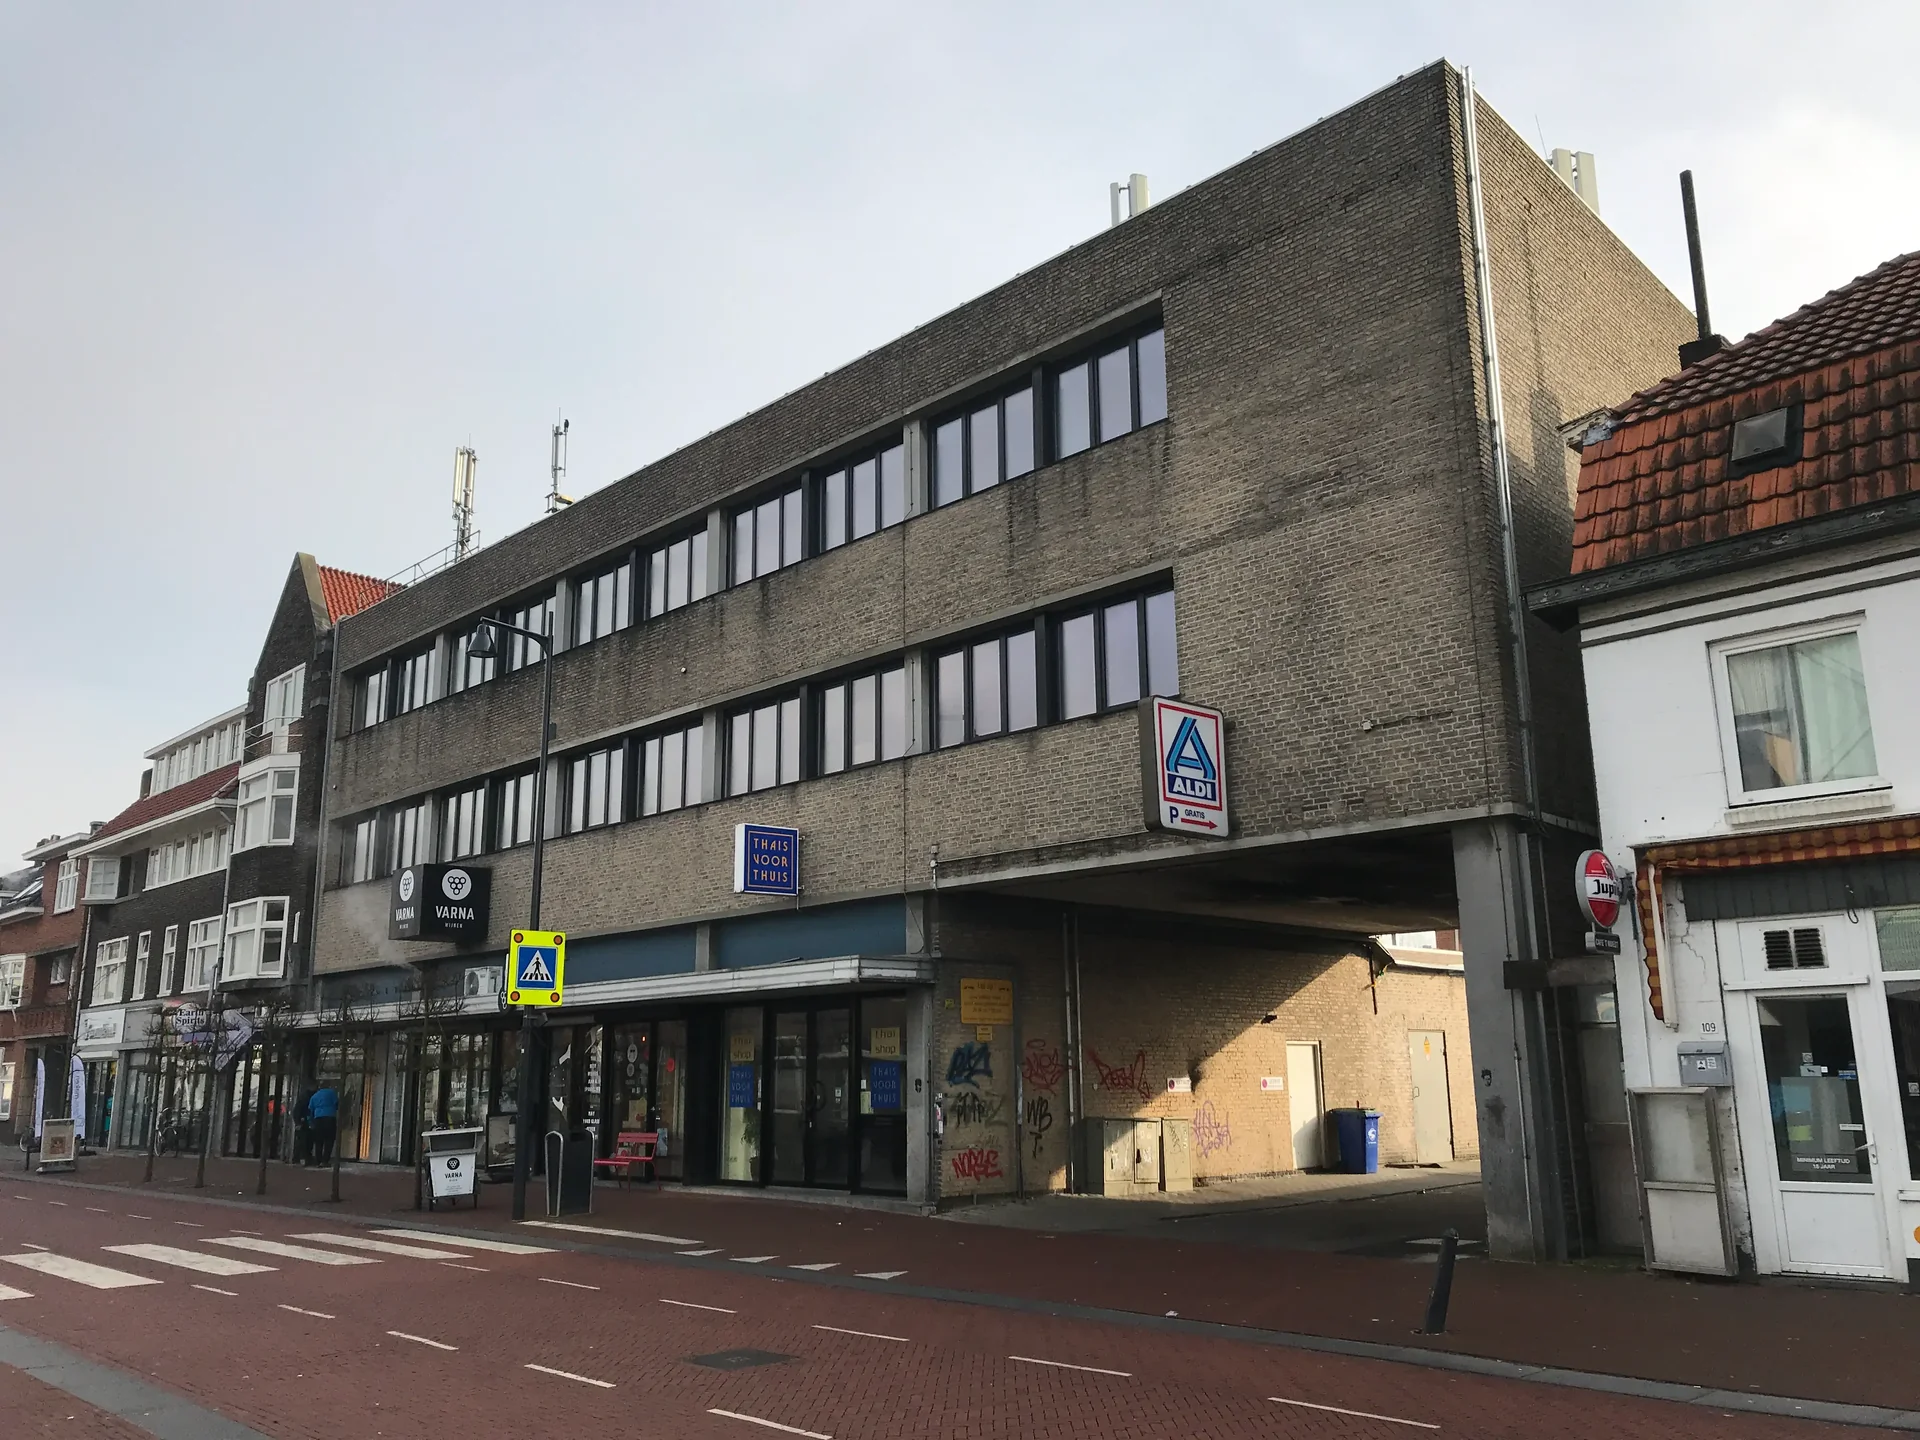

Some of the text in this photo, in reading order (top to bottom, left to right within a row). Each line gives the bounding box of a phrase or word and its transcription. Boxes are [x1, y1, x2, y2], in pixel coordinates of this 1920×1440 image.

[1172, 777, 1212, 799] ALDI
[1169, 806, 1206, 824] P GRATIS
[753, 838, 789, 852] THAIS
[753, 854, 788, 867] VOOR
[753, 869, 788, 883] THUIS
[395, 906, 415, 922] VARNA
[435, 905, 475, 920] VARNA
[1701, 1022, 1716, 1033] 109
[875, 1044, 896, 1055] shop
[873, 1080, 896, 1089] VOOR
[1796, 1156, 1823, 1164] MINIMUM
